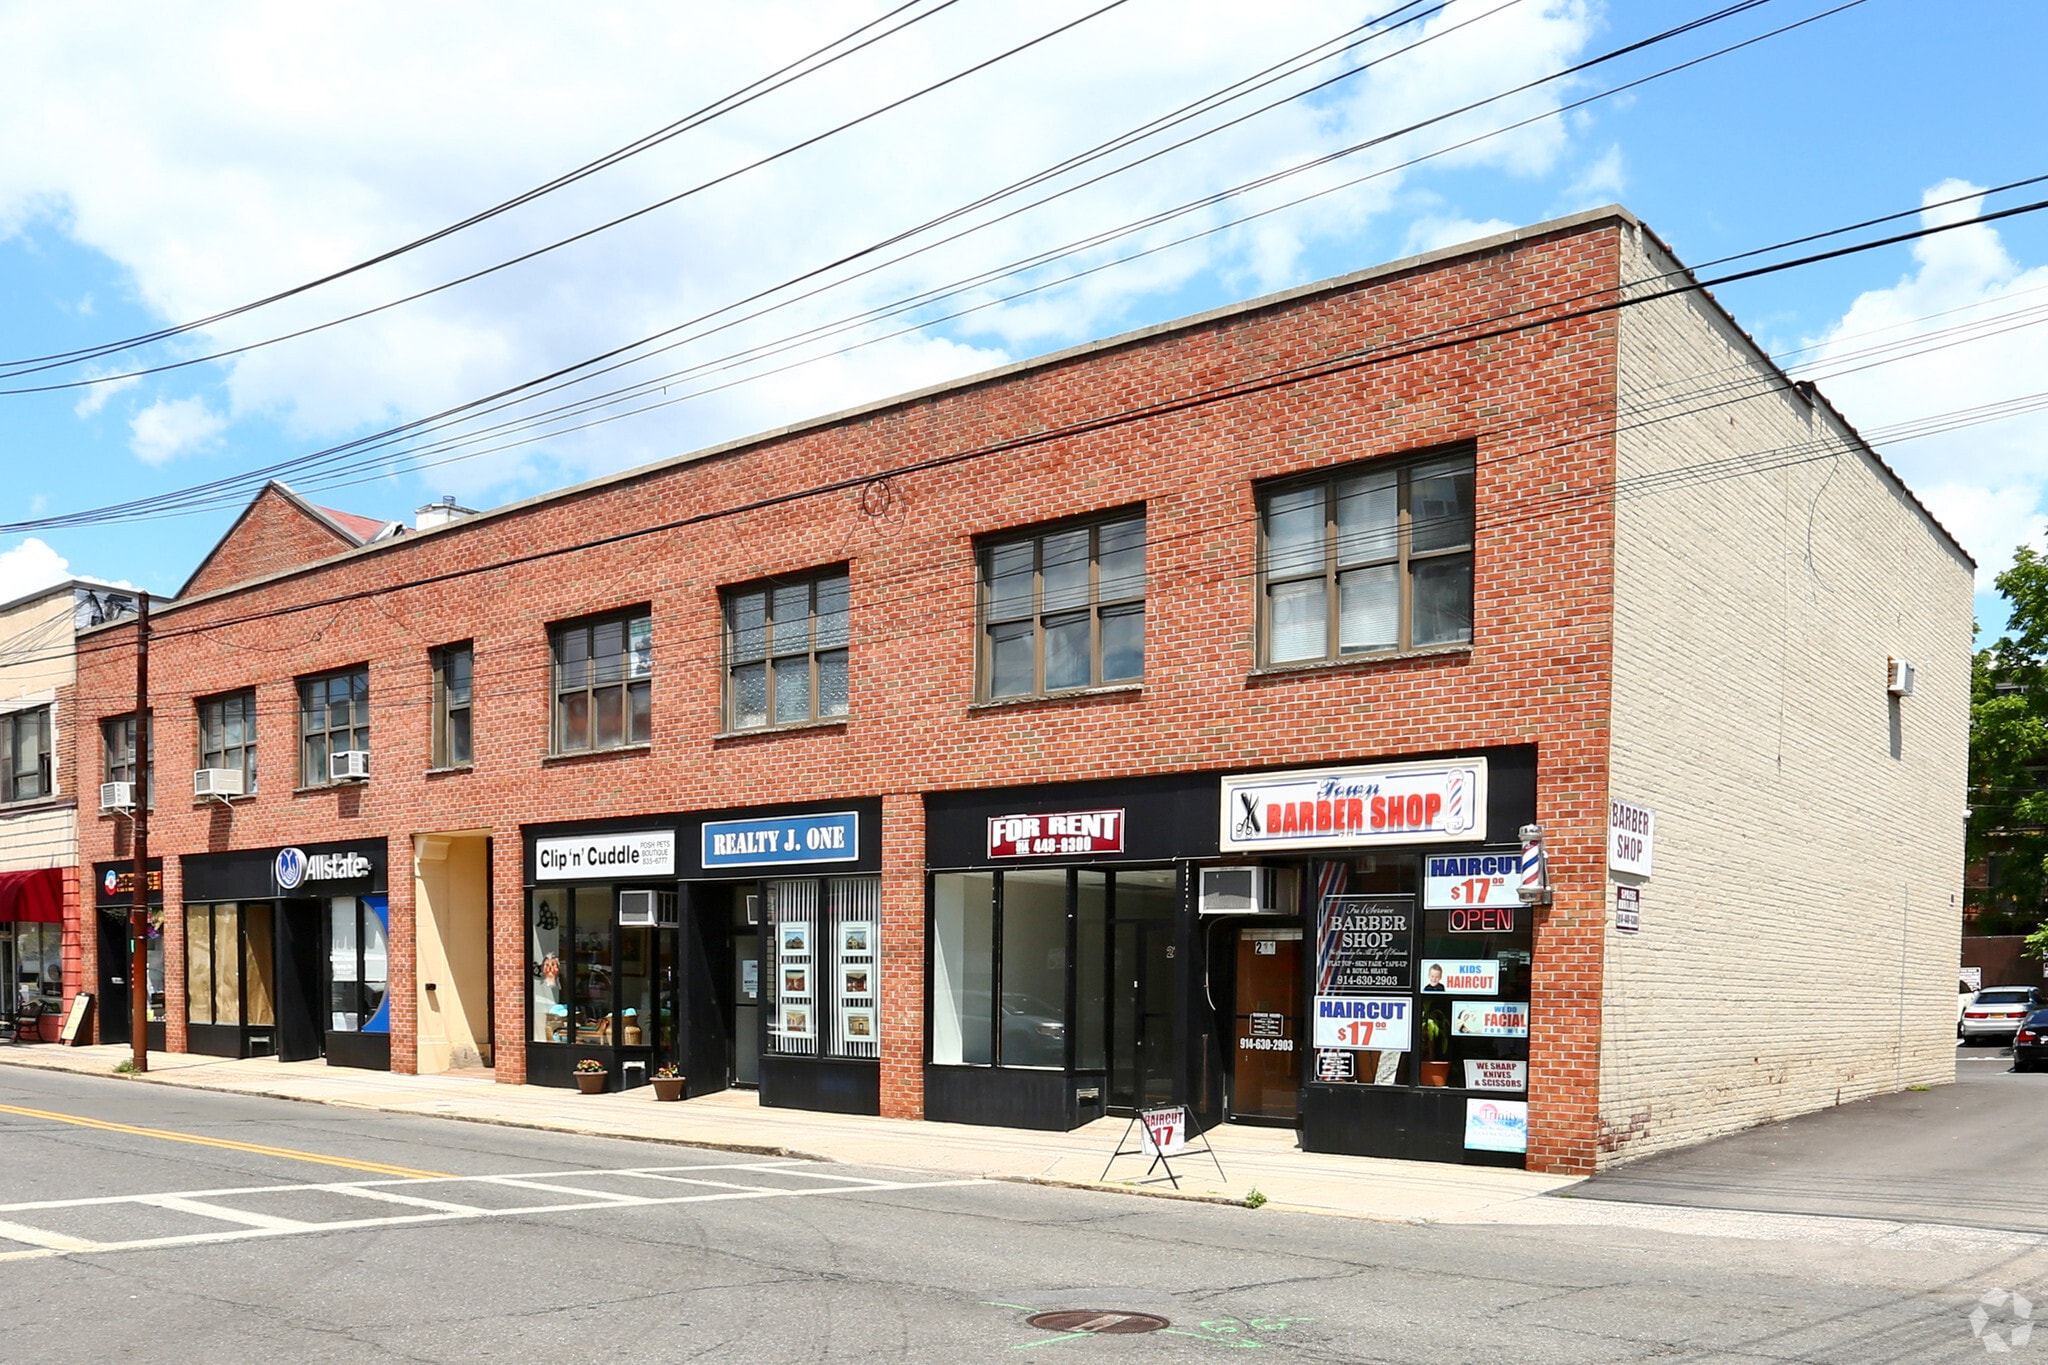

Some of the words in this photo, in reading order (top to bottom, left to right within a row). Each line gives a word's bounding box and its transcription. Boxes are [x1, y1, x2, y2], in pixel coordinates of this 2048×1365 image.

[1317, 776, 1380, 798] Town
[1266, 797, 1363, 834] BARBER
[1371, 792, 1442, 829] SHOP
[1612, 803, 1649, 836] BARBER
[992, 817, 1040, 848] FOR
[1048, 813, 1119, 841] RENT
[640, 841, 655, 849] POSH
[656, 840, 671, 848] PETS
[713, 830, 780, 856] REALTY
[784, 829, 802, 852] J.
[806, 826, 845, 850] ONE
[1033, 836, 1092, 853] 448-8300
[1617, 834, 1643, 863] SHOP
[540, 849, 567, 871] Clip
[587, 844, 640, 866] Cuddle
[642, 848, 669, 857] BOUTIQUE
[304, 852, 369, 880] Allstate
[1431, 856, 1523, 877] HAIRCUT
[1366, 903, 1394, 914] Service
[1330, 915, 1408, 931] BARBER
[1451, 909, 1512, 931] OPEN
[1342, 932, 1394, 948] SHOP
[1459, 965, 1482, 974] KIDS
[1336, 975, 1398, 986] 914-630-2903
[1446, 975, 1494, 989] HAIRCUT
[1319, 1001, 1407, 1020] HAIRCUT
[1484, 1013, 1527, 1028] FACIAL
[1239, 1037, 1294, 1052] 914-630-2903
[1476, 1062, 1489, 1070] WE
[1490, 1063, 1517, 1071] SHARP
[1483, 1071, 1512, 1079] KNIVES
[1474, 1079, 1481, 1087] &
[1481, 1079, 1522, 1088] SCISSORS
[1483, 1108, 1519, 1122] Trinity
